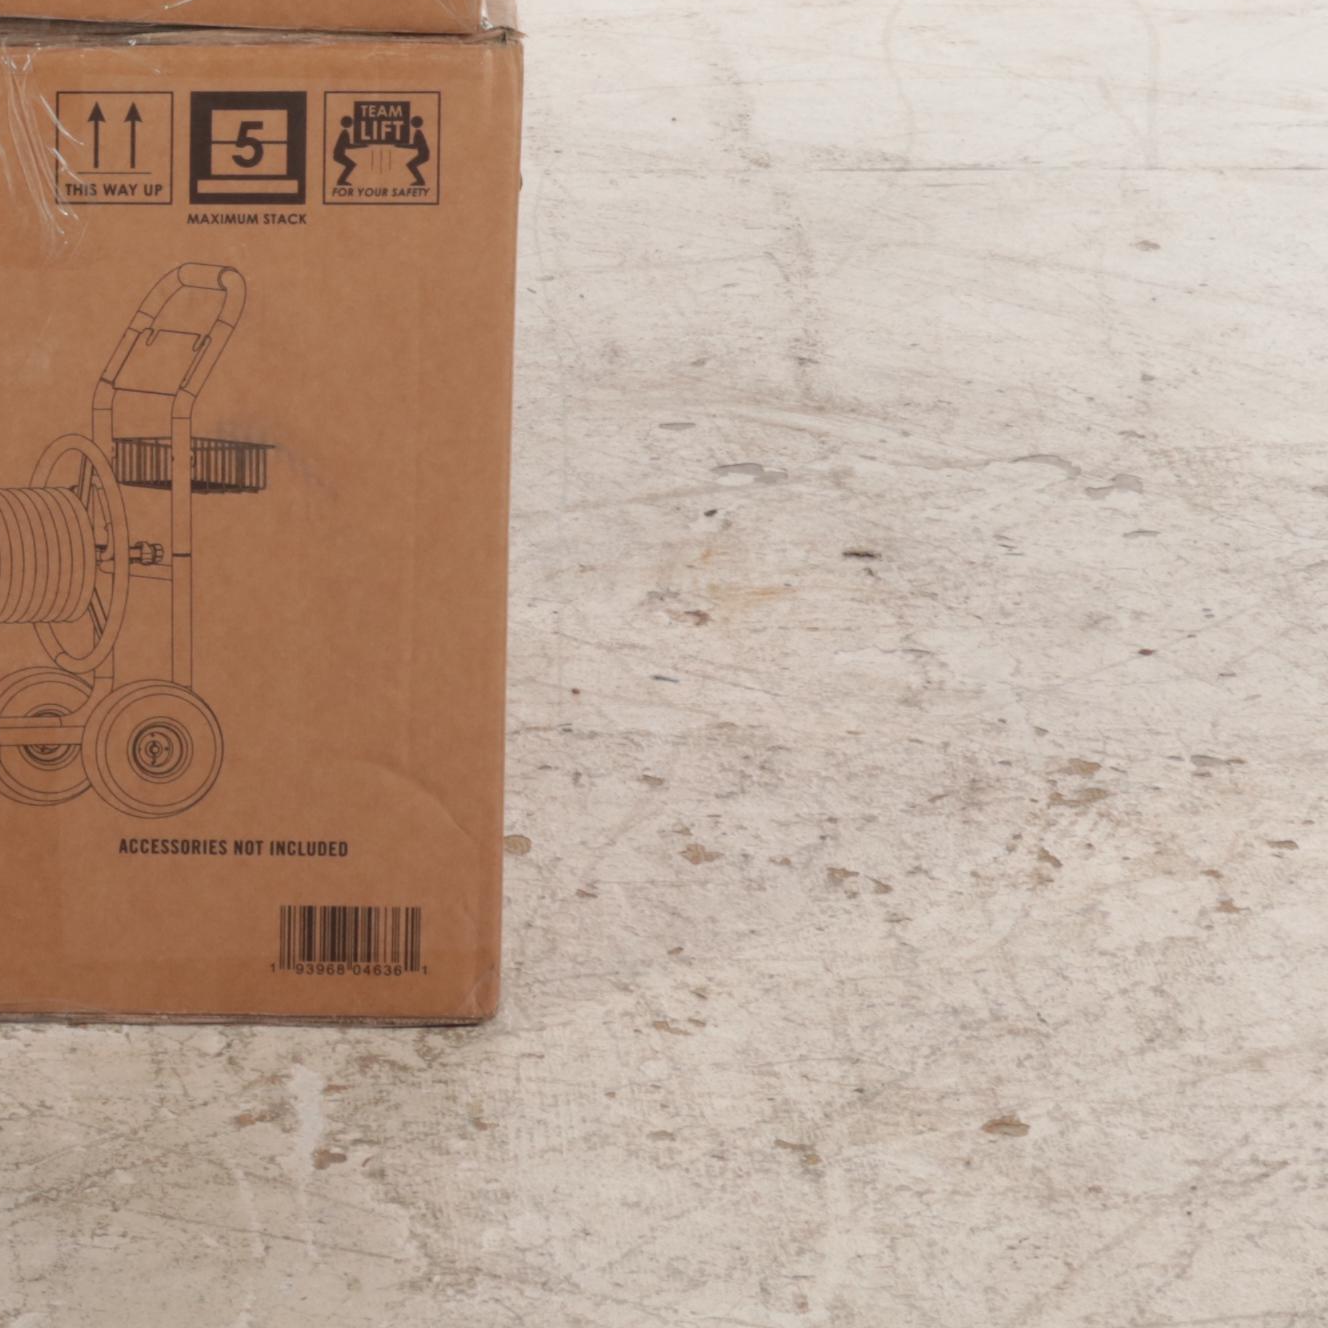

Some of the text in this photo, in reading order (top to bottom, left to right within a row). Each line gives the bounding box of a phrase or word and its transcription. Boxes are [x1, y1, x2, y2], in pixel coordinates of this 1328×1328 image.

[360, 104, 402, 118] TEAM
[359, 118, 403, 141] LIFT
[232, 122, 264, 169] 5
[65, 183, 163, 197] THIS WAY UP
[333, 187, 430, 198] FOR YOUR SAFETY
[187, 213, 307, 226] MAXIMUM STACK
[119, 839, 348, 857] ACCESSORIES NOT INCLUDED
[296, 964, 345, 975] 93968
[353, 965, 402, 976] 04636
